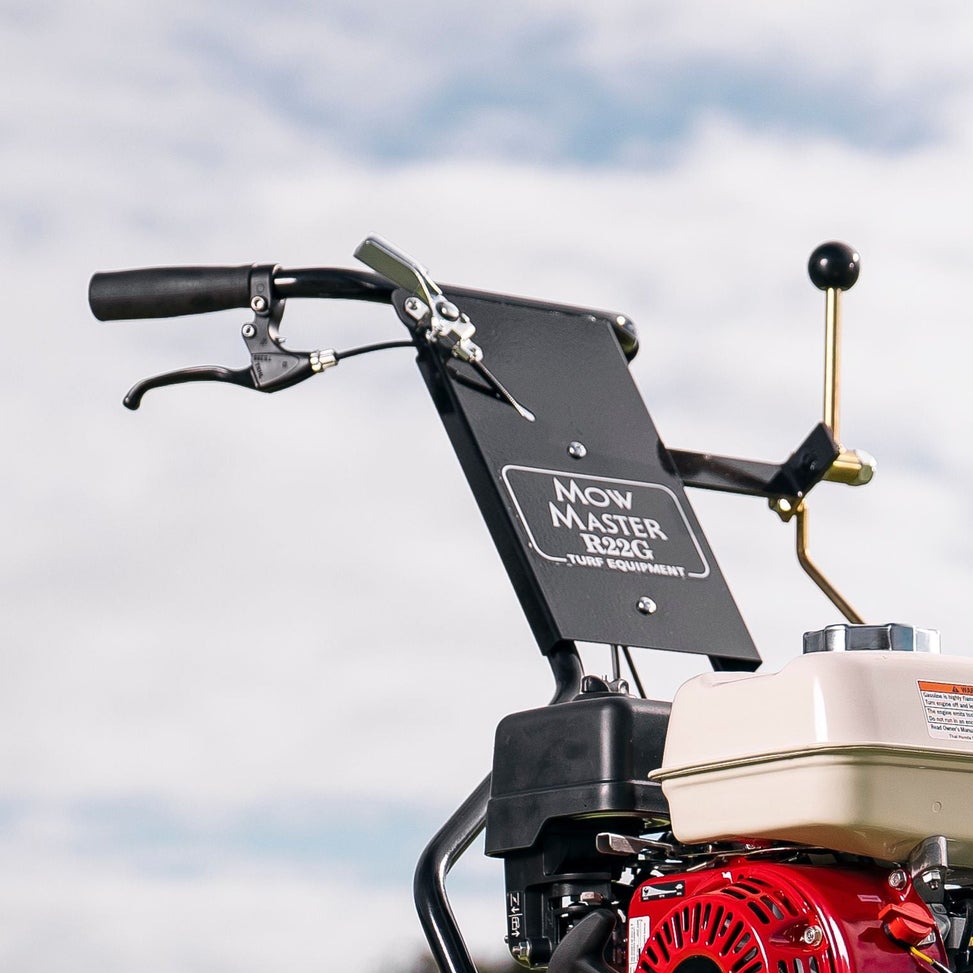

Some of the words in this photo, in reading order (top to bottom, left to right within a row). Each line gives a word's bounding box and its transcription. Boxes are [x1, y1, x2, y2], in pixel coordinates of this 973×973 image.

[553, 477, 632, 510] MOW
[549, 502, 668, 540] MASTER
[580, 533, 654, 560] R22G
[567, 554, 604, 568] TURF
[608, 558, 686, 576] EQUIPMENT
